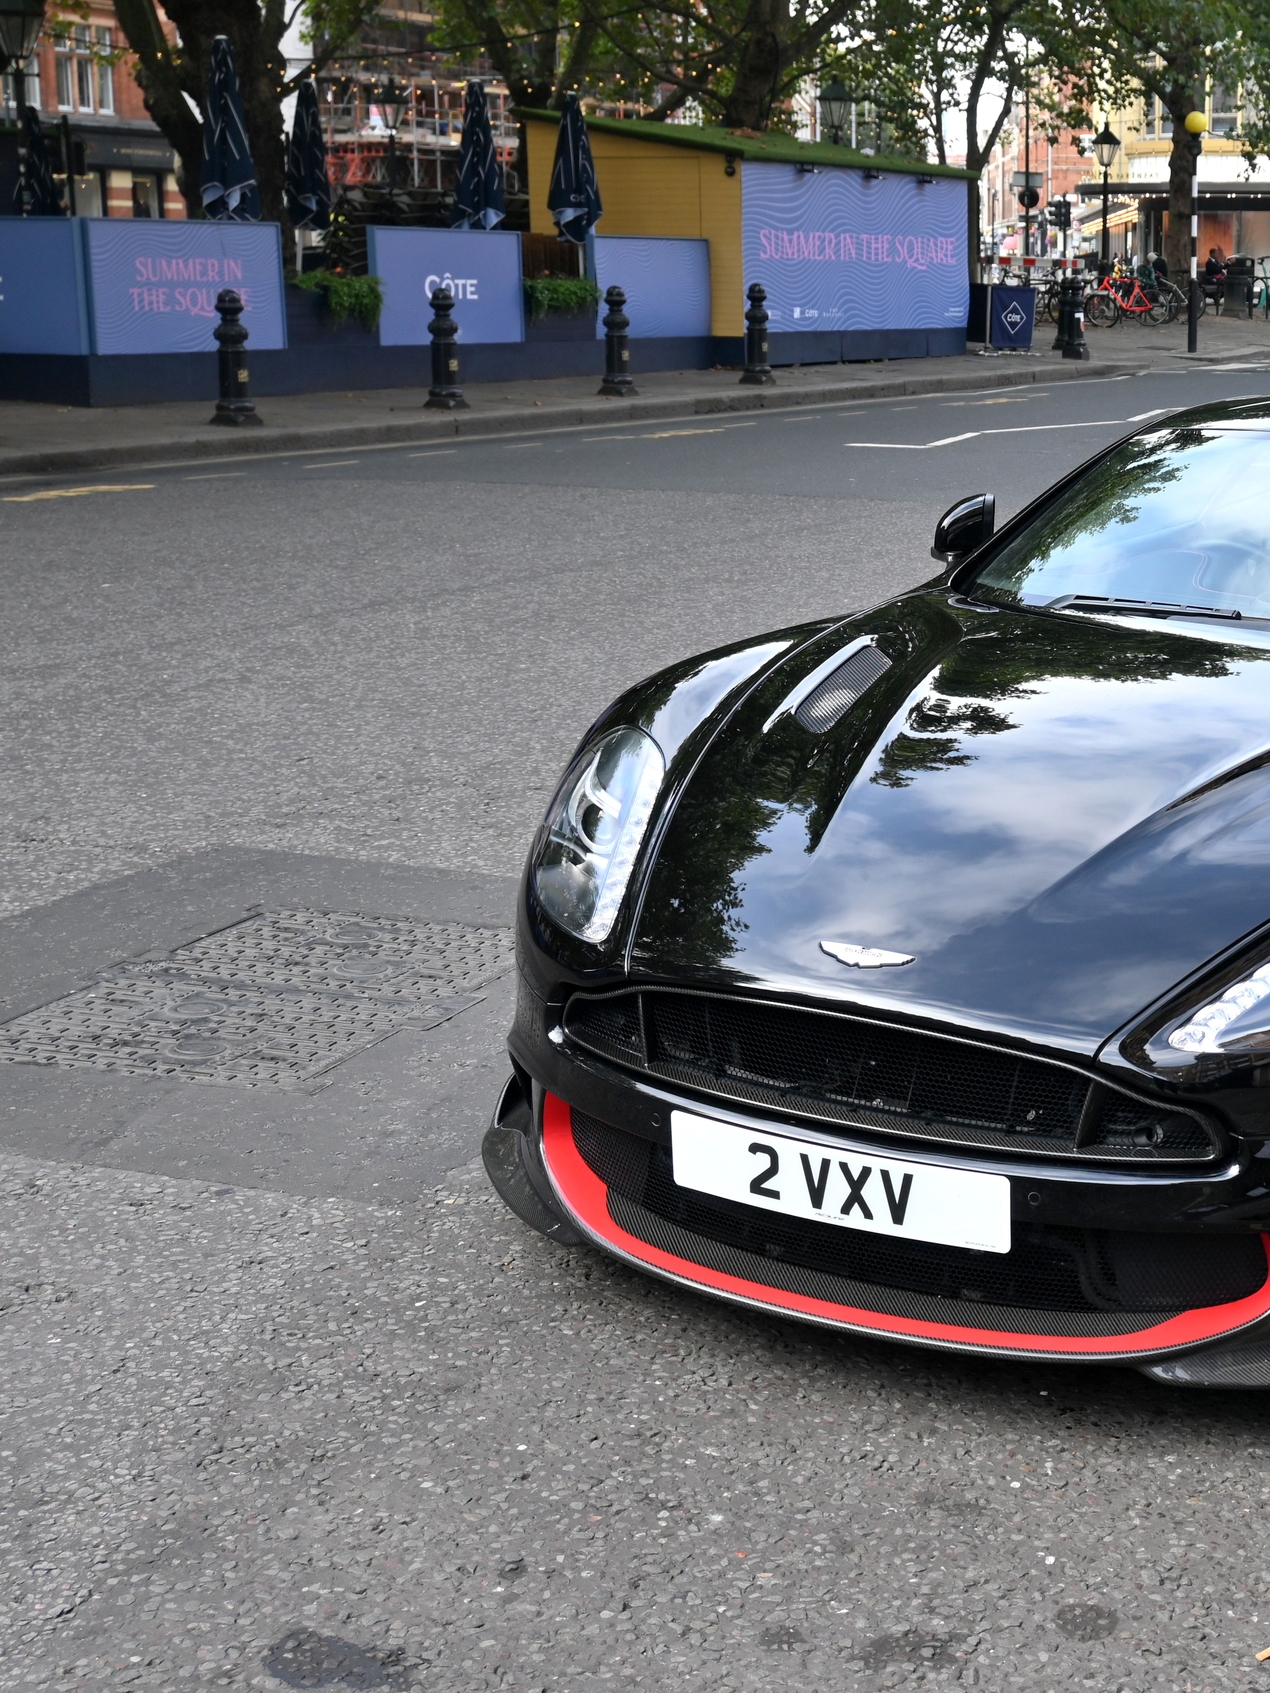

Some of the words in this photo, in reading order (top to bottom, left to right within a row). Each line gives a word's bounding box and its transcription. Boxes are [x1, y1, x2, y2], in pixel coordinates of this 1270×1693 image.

[759, 229, 836, 261] SUMMER
[840, 232, 857, 261] IN
[860, 233, 892, 262] THE
[895, 234, 957, 270] SQUARE
[135, 257, 221, 282] SUMMER
[224, 259, 243, 282] IN
[129, 287, 172, 312] THE
[174, 287, 253, 317] SQUE
[748, 1142, 781, 1201] 2
[799, 1152, 914, 1226] VXV
